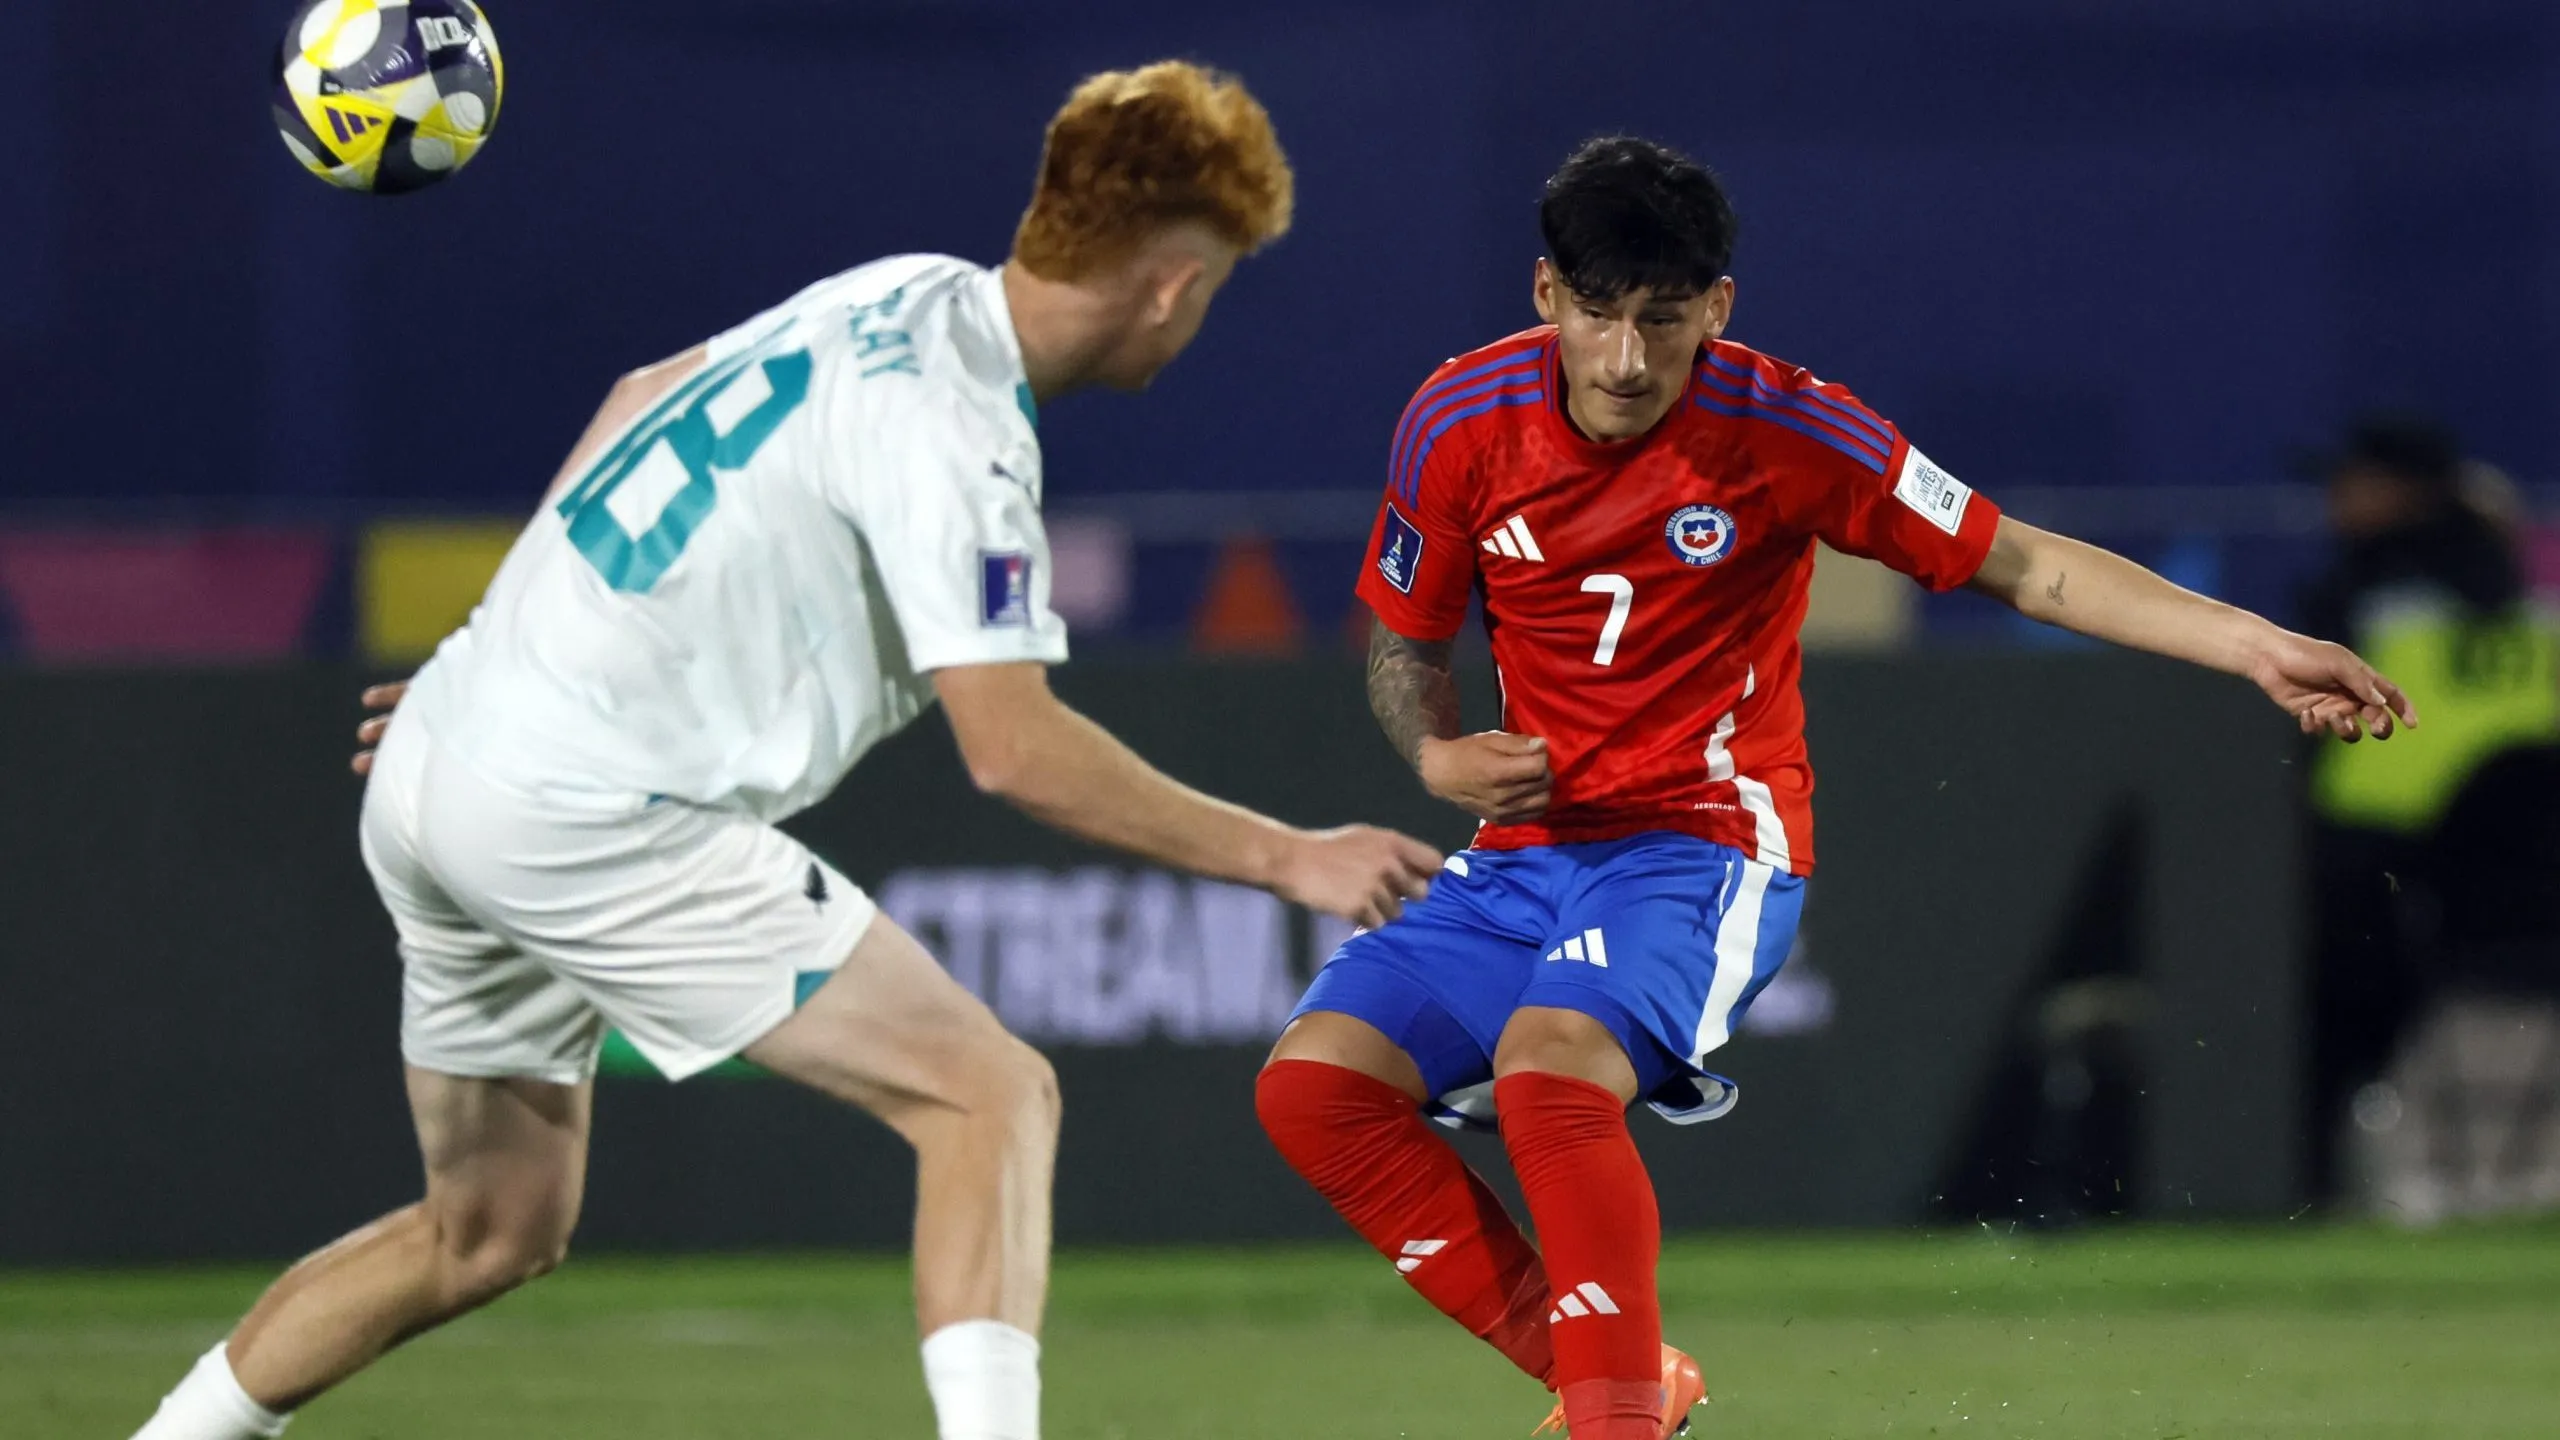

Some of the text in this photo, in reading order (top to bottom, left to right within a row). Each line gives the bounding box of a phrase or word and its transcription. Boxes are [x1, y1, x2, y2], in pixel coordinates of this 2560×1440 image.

[556, 315, 813, 593] 18
[1685, 551, 1723, 565] DE CHILE
[1580, 573, 1634, 666] 7
